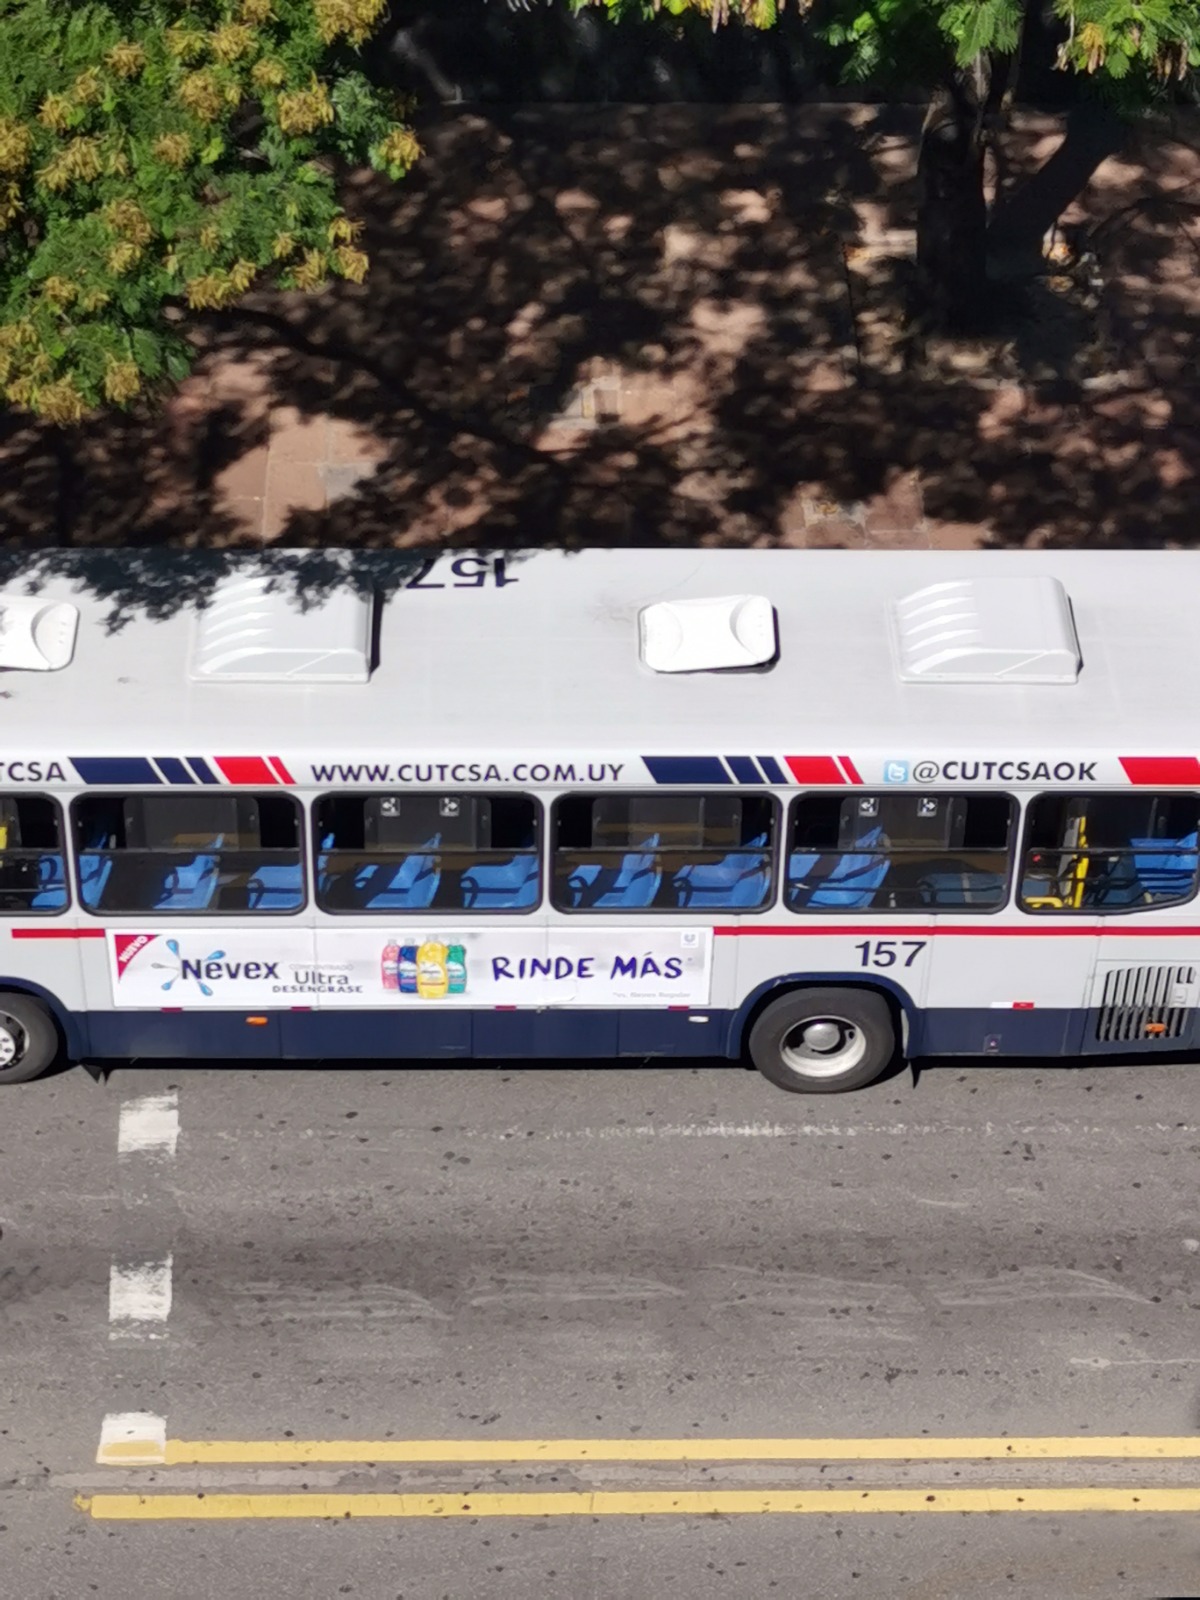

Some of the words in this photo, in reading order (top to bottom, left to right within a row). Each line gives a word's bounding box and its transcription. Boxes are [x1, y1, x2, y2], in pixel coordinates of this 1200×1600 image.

[405, 557, 519, 589] 157
[310, 763, 625, 782] WWW.CUTCSA.COM.UY
[912, 760, 1098, 783] @CUTCSAOK
[855, 941, 926, 967] 157
[181, 959, 281, 980] Nevex
[294, 971, 349, 985] Ultra
[491, 956, 595, 981] RINDE
[272, 985, 363, 994] DESENGRASE
